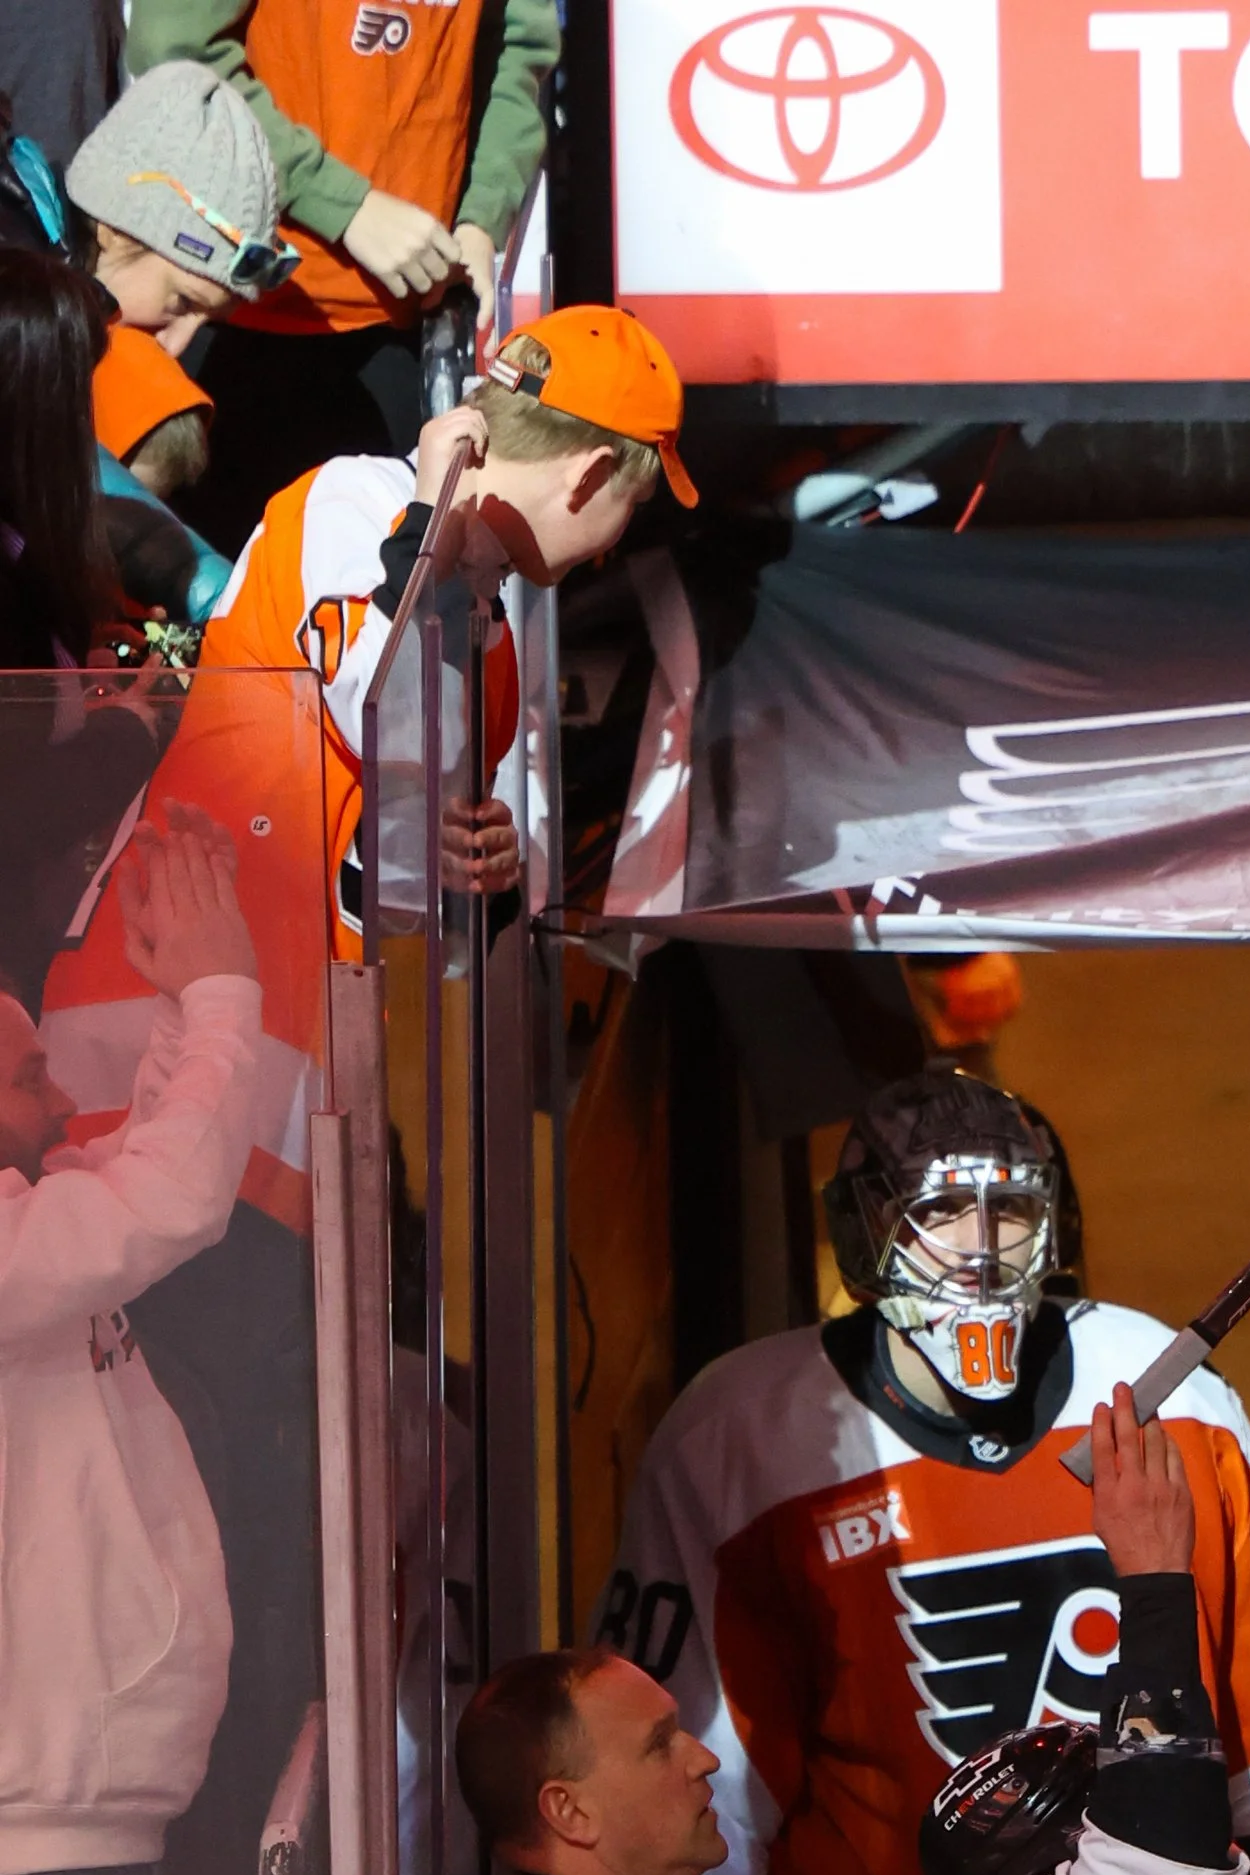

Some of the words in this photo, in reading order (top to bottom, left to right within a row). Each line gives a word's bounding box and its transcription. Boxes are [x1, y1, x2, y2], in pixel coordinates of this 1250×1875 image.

[955, 1319, 1018, 1388] 80
[818, 1490, 911, 1563] IBX
[943, 1763, 1015, 1831] CHEVROLET
